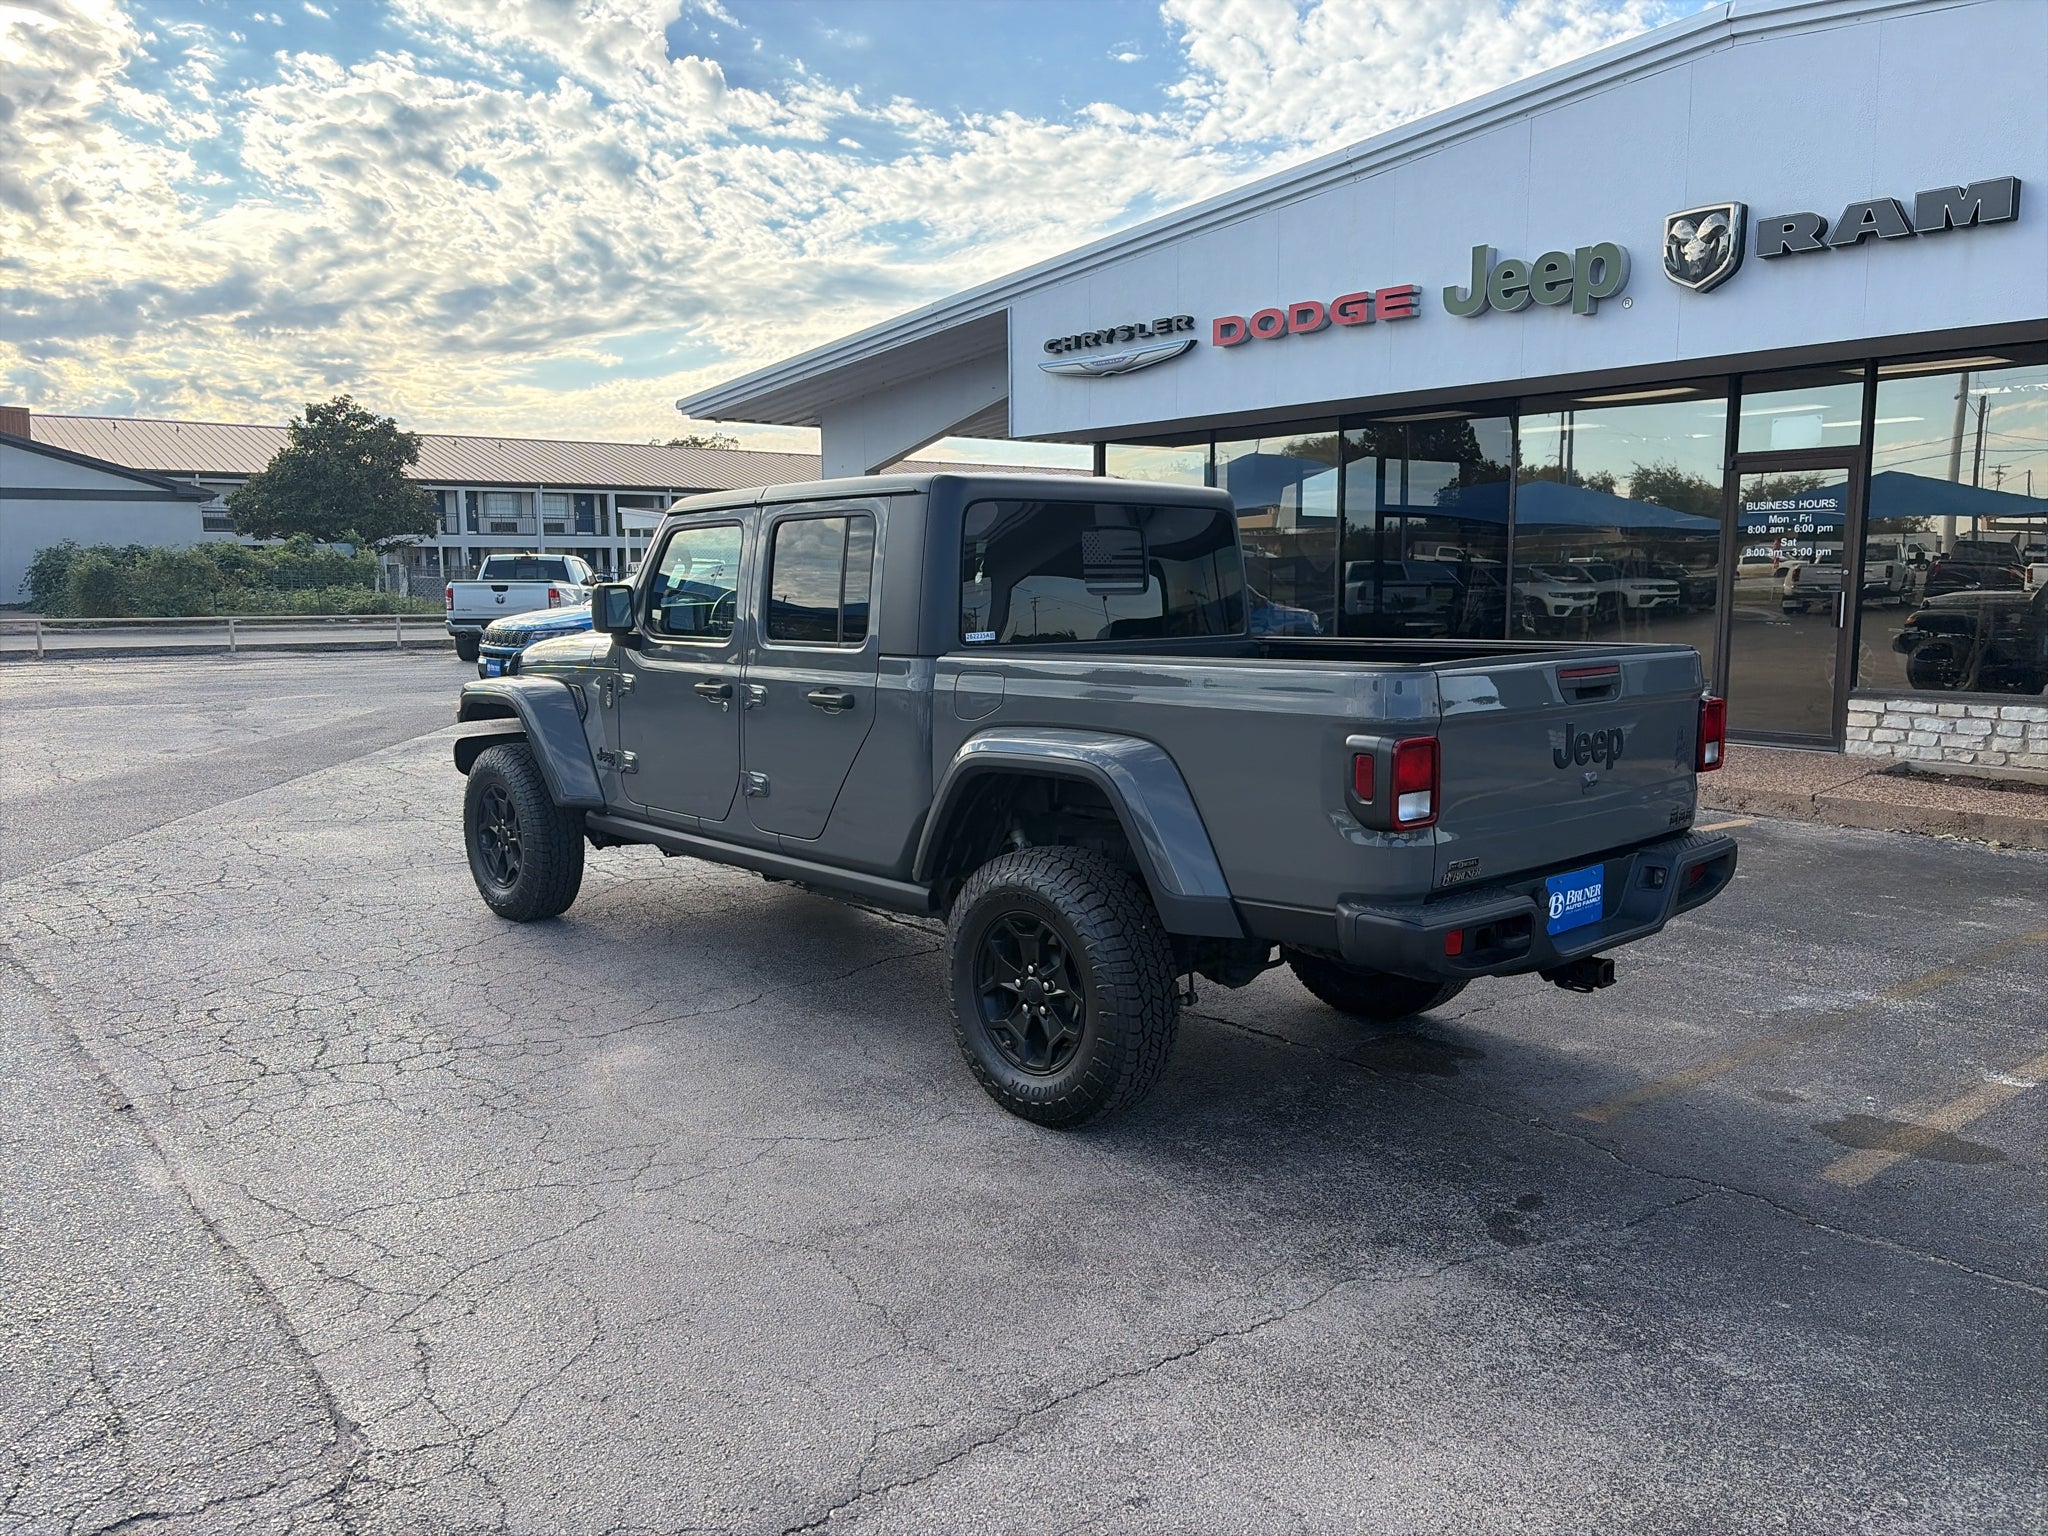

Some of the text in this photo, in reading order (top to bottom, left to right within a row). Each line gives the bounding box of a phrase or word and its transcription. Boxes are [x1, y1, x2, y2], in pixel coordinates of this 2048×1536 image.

[1755, 176, 2021, 258] RAM
[1443, 242, 1631, 317] Jeep
[1213, 284, 1422, 347] DODGE
[1044, 314, 1195, 353] CHRYSLER
[1746, 498, 1838, 511] BUSINESS HOURS:
[1768, 514, 1790, 524] Mon
[1799, 513, 1812, 522] Fri
[1747, 525, 1767, 534] 8:00
[1794, 524, 1814, 533] 6:00
[1817, 525, 1834, 534] pm
[1780, 538, 1797, 547] Sat
[1746, 548, 1765, 557] 8:00
[1768, 549, 1783, 557] am
[1791, 547, 1813, 556] 3:00
[1815, 548, 1832, 558] pm
[1553, 722, 1624, 770] Jeep
[1565, 902, 1582, 911] AUTO
